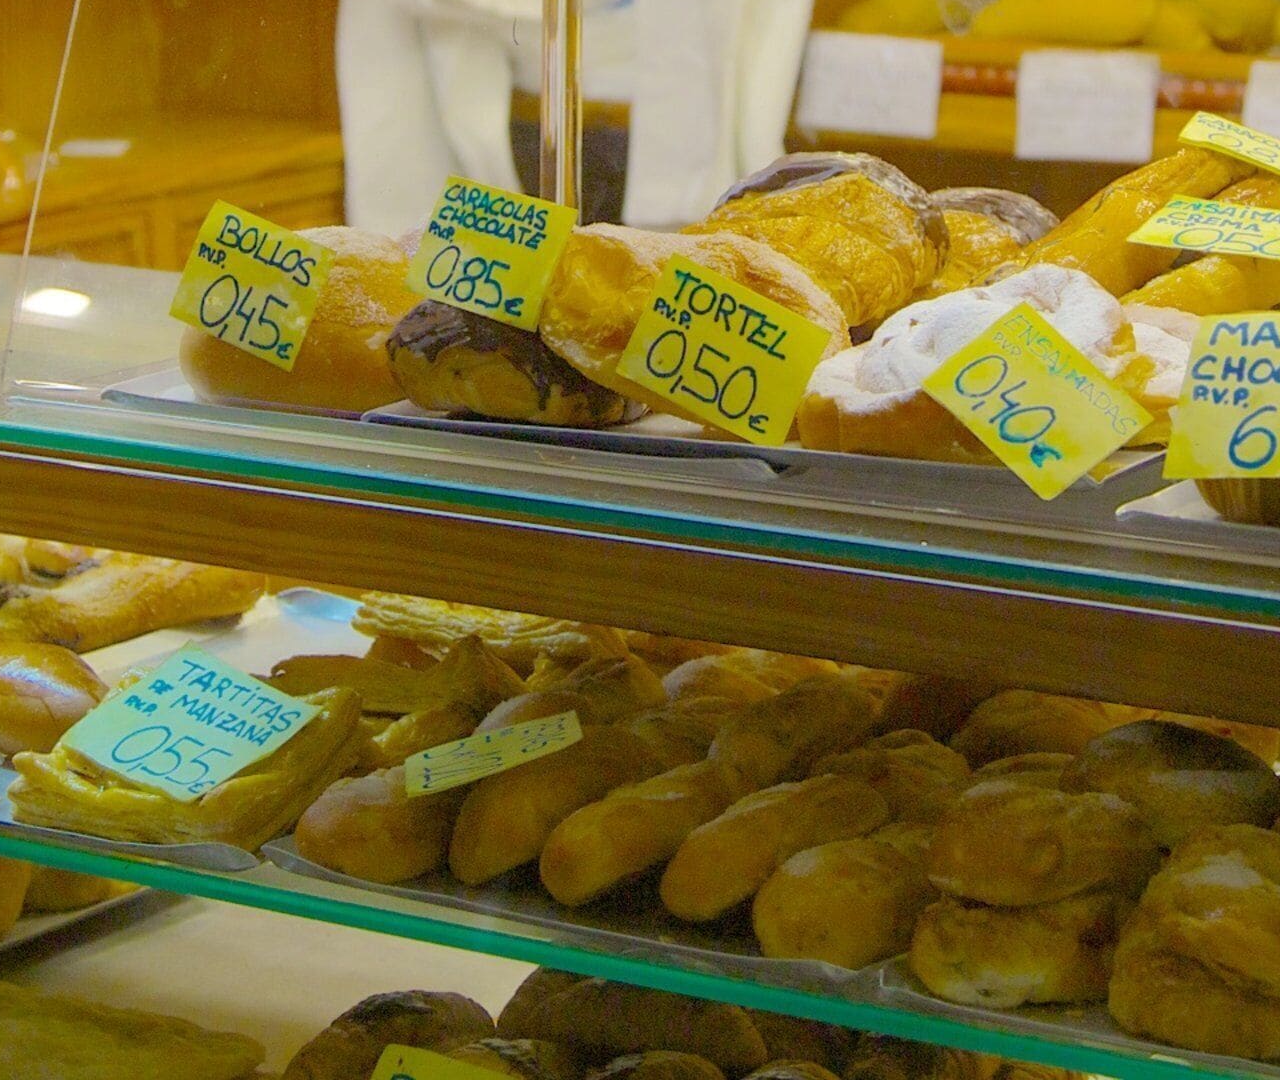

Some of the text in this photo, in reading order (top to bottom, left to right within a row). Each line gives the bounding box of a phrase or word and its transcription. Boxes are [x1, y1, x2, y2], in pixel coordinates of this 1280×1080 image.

[437, 206, 547, 251] CHOCOLATE
[443, 183, 549, 229] CARACOLAS
[1169, 212, 1261, 233] CREMA
[216, 214, 316, 287] BOLLOS
[674, 269, 787, 360] TORTEL
[170, 694, 275, 748] MANZANA
[175, 659, 301, 733] TARTITAS
